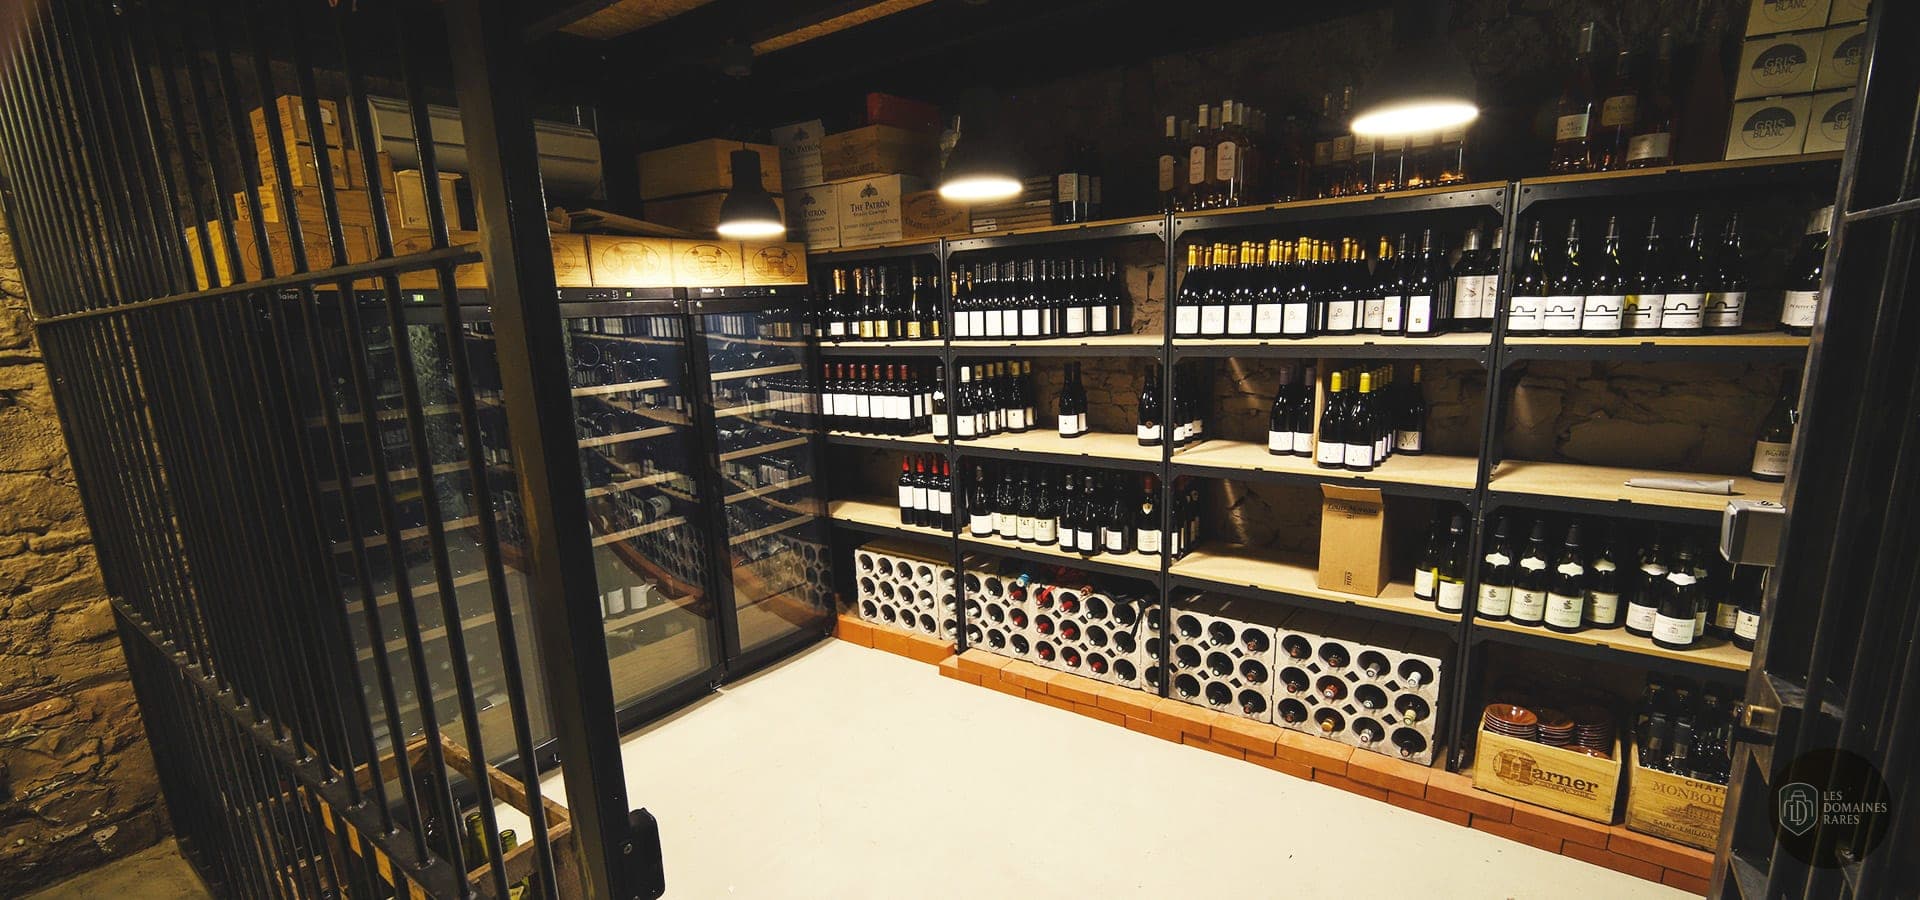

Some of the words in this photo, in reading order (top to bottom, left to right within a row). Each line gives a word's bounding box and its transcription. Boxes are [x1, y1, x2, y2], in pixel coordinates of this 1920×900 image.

[1764, 55, 1798, 68] GRIS
[1763, 64, 1794, 76] BLANC
[1754, 118, 1785, 130] GRIS
[1752, 127, 1784, 138] BLANC
